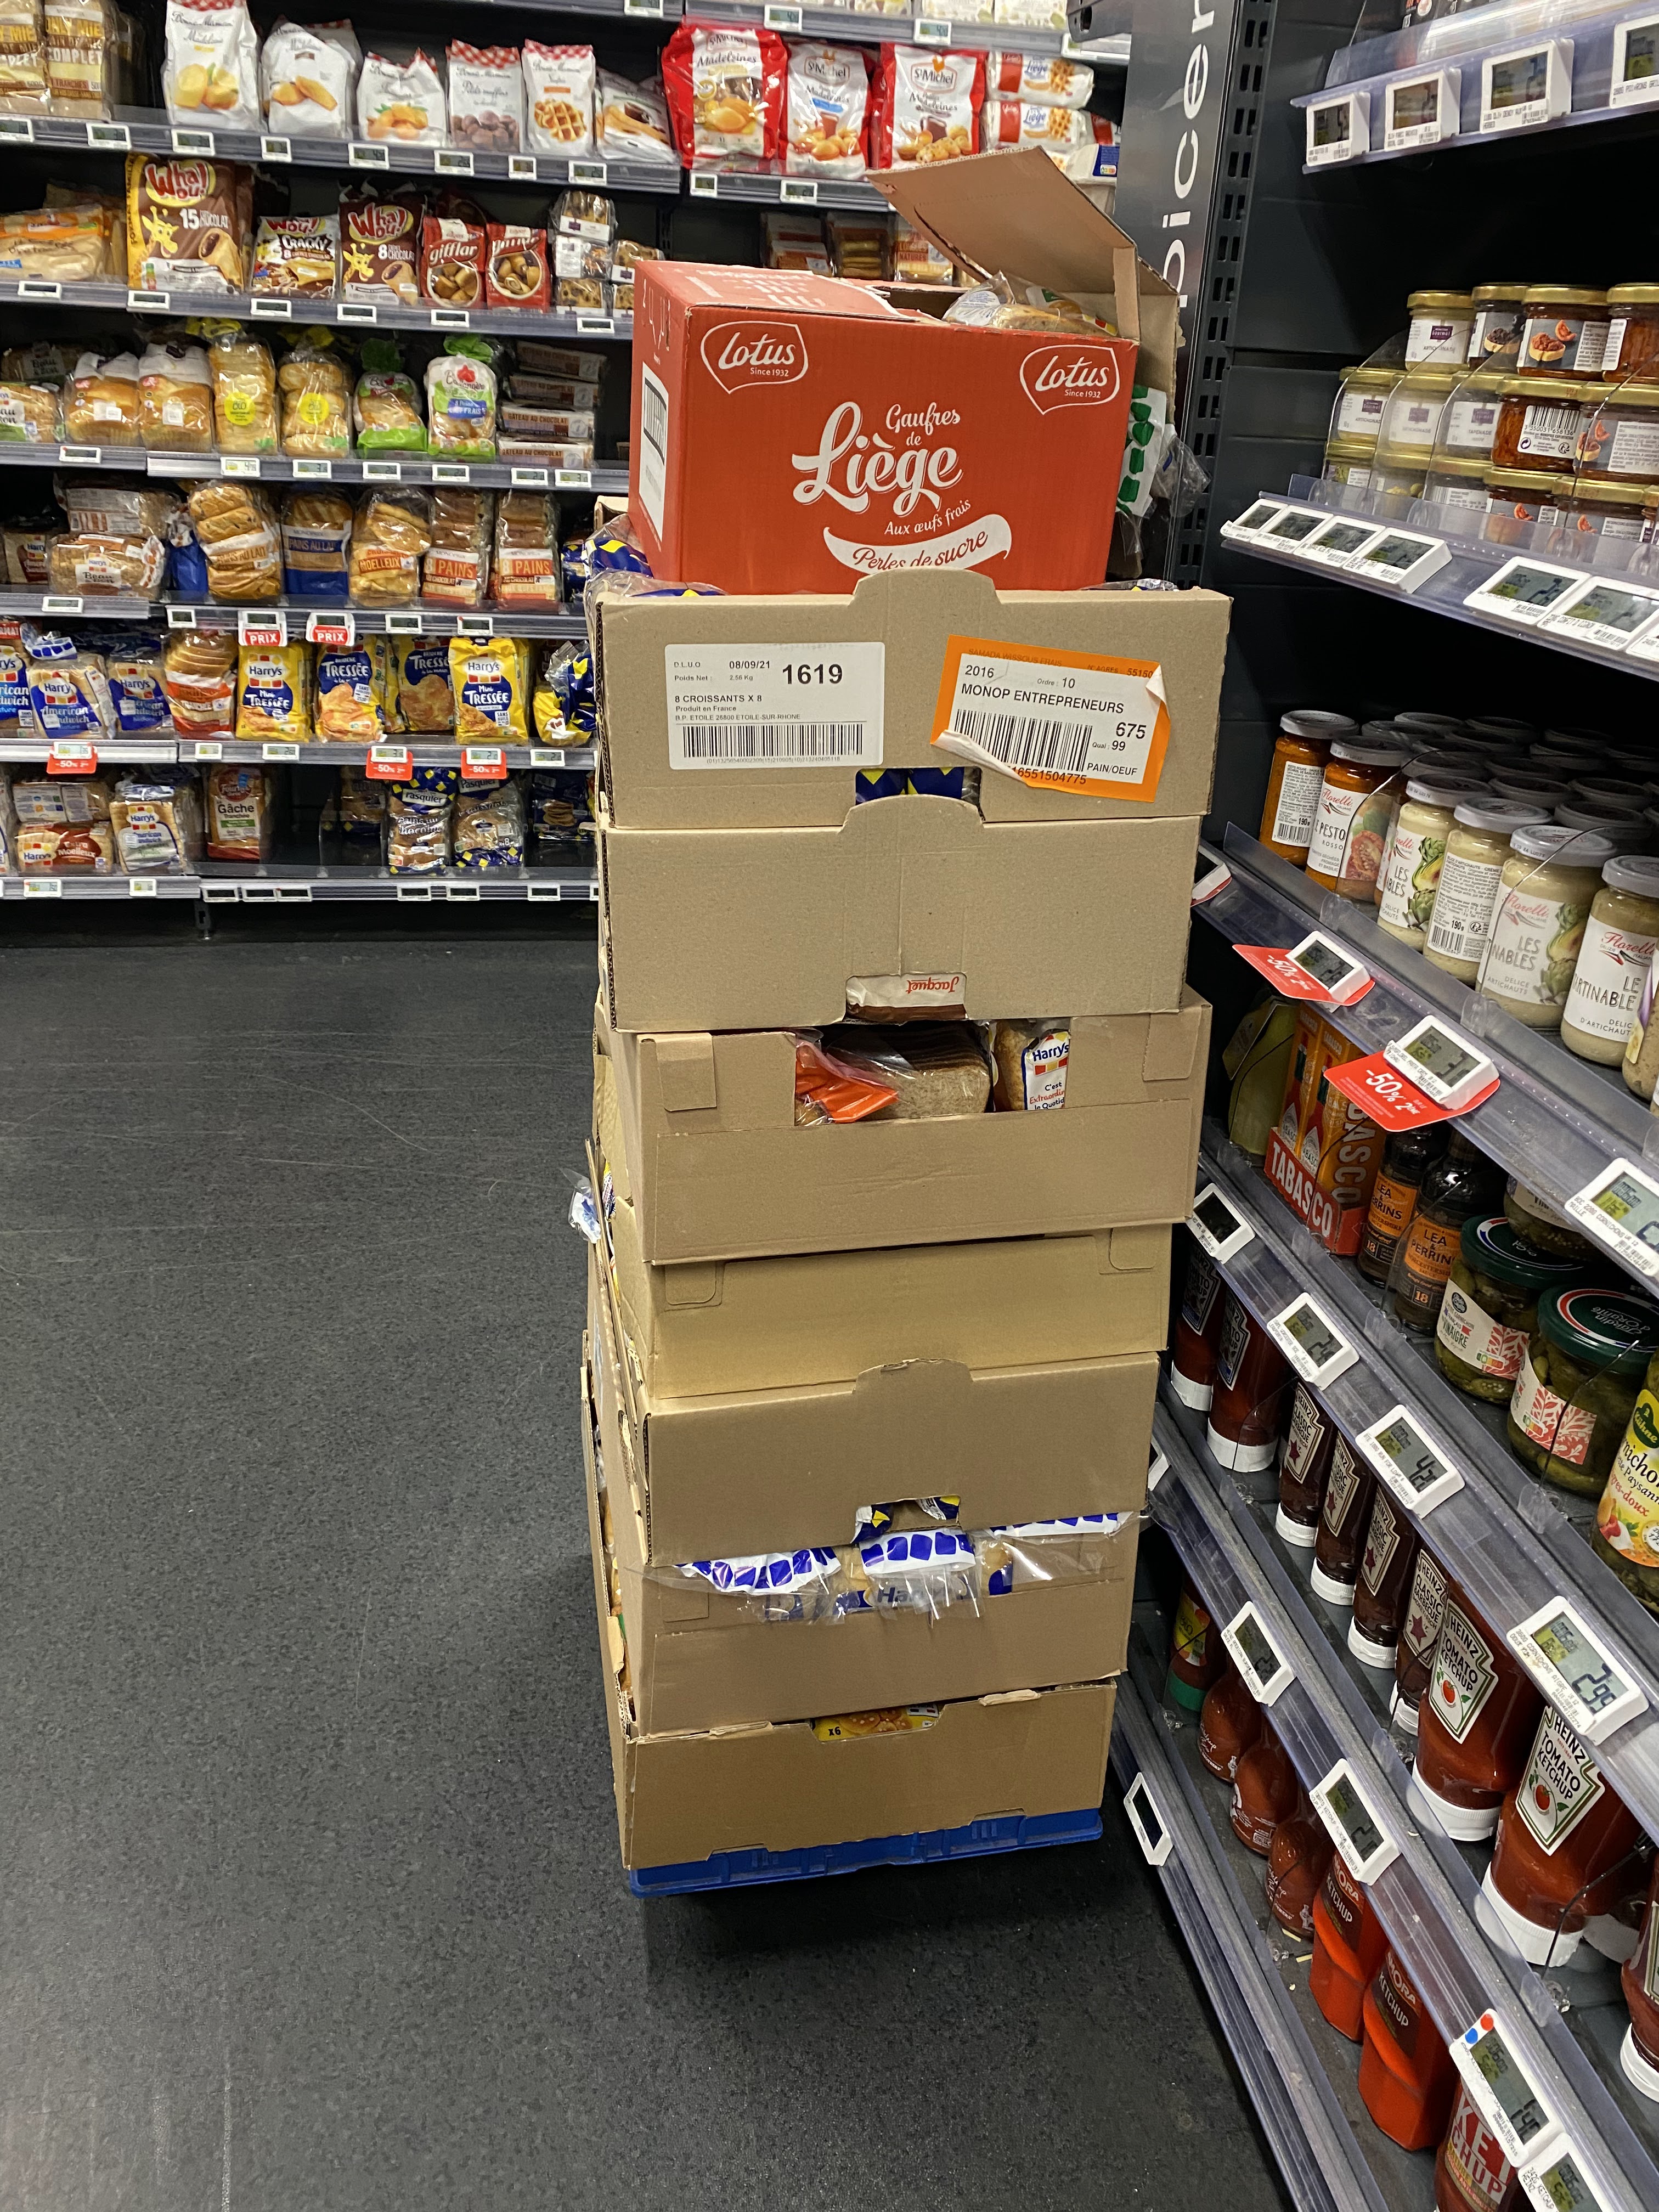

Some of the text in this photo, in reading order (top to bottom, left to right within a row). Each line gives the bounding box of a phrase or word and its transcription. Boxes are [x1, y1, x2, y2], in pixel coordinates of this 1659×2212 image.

[179, 208, 200, 229] 15
[378, 244, 388, 259] 8
[428, 245, 478, 266] gifflar
[718, 332, 796, 370] Lotus
[750, 366, 789, 377] Since 1932
[1035, 355, 1109, 392] Lotus
[1064, 388, 1102, 399] Since 1932
[885, 402, 961, 435] Gaufres
[906, 432, 922, 445] de
[791, 402, 963, 517] Liège
[884, 521, 909, 535] Aux
[945, 498, 972, 526] frais
[852, 529, 989, 571] Perles de sucre
[425, 559, 474, 579] 8 PAINS
[503, 560, 550, 575] 8 PAINS
[249, 634, 278, 645] PRIX
[317, 633, 345, 641] PRIX
[320, 661, 369, 678] TRESSÉE
[729, 660, 771, 670] 08/09/21
[782, 663, 843, 685] 1619
[964, 664, 1076, 689] 2016 Ordre 10
[464, 690, 510, 704] TRESSÉE
[682, 694, 746, 703] CROISSANTS
[961, 683, 1125, 714] MONOP ENTREPRENEURS
[1115, 721, 1147, 740] 675
[1092, 740, 1126, 752] Qual 99
[1087, 761, 1138, 777] PAIN/OEUF
[218, 803, 255, 815] Gâche
[1319, 822, 1347, 842] PESTO
[1322, 841, 1344, 850] ROSSO
[1394, 864, 1410, 883] LES
[1517, 935, 1542, 954] LES
[1267, 955, 1298, 978] -50%
[905, 975, 960, 994] Jacquet
[1504, 975, 1530, 989] DELICE
[1623, 975, 1642, 994] LE
[1045, 1081, 1063, 1091] C'est
[1365, 1069, 1406, 1102] -50%
[1271, 1141, 1333, 1238] TABASCO
[1376, 1183, 1392, 1199] LEA
[1574, 1195, 1585, 1205] BOC
[1366, 1239, 1376, 1252] 18
[1424, 1229, 1447, 1246] LEA
[1415, 1290, 1429, 1304] 18
[1442, 1320, 1470, 1348] VINAIGRE
[1363, 1433, 1372, 1442] BTE
[1421, 1564, 1444, 1596] HEINZ
[1413, 1585, 1440, 1624] BARBECUE
[1415, 1573, 1443, 1616] CLASSIC
[1450, 1615, 1480, 1659] HEINZ
[1443, 1630, 1479, 1684] TOMATO
[1441, 1649, 1474, 1692] KETCHUP
[828, 1726, 841, 1736] x6
[1554, 1716, 1587, 1765] HEINZ
[1542, 1730, 1581, 1792] TOMATO
[1537, 1747, 1573, 1800] KETCHUP
[1323, 1806, 1337, 1825] KETCHUP
[1326, 1872, 1353, 1923] KETCHUP
[1378, 1971, 1409, 2027] KETCHUP
[1453, 2124, 1503, 2195] CHUP
[1521, 2172, 1536, 2193] HEINZ
[1538, 2183, 1554, 2209] KETCHUP
